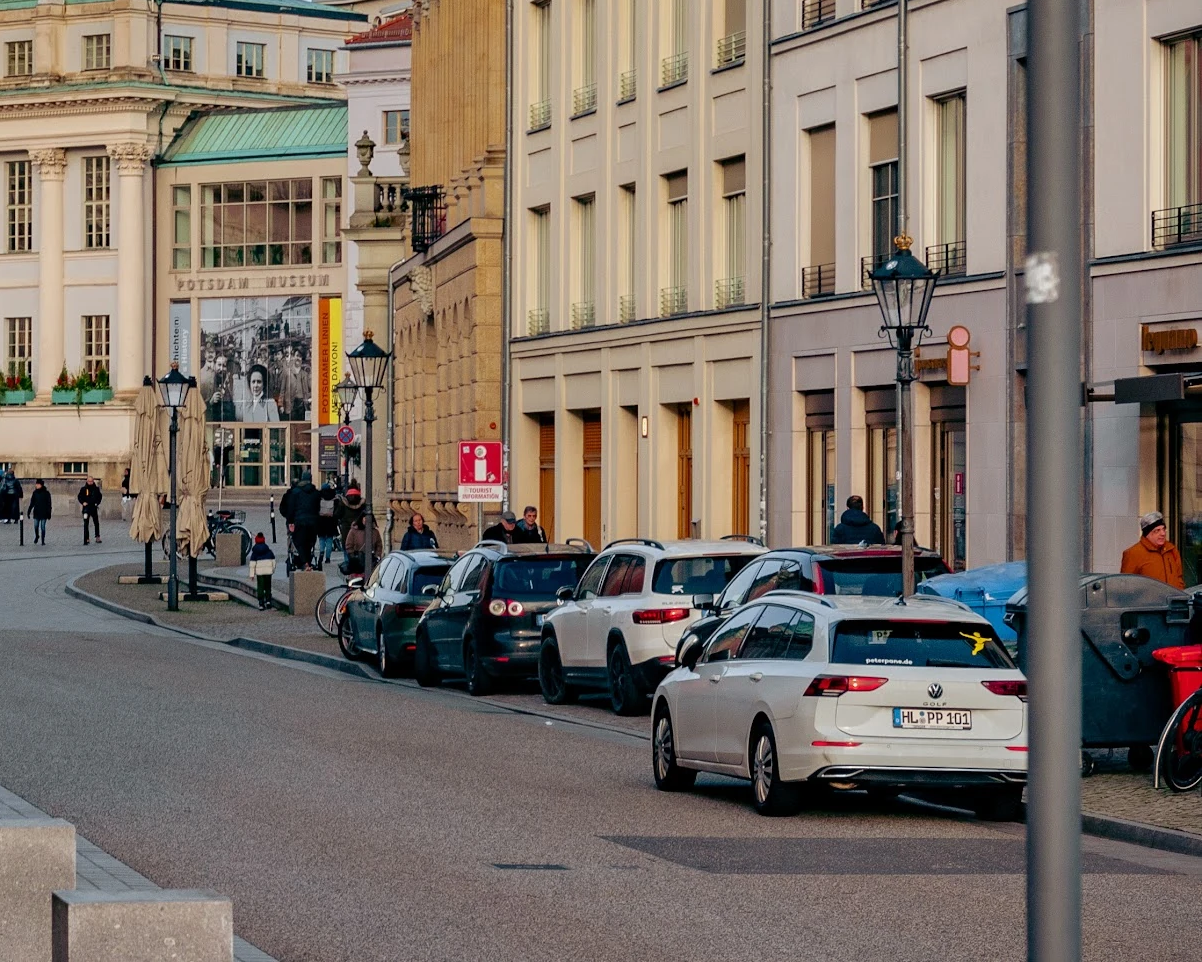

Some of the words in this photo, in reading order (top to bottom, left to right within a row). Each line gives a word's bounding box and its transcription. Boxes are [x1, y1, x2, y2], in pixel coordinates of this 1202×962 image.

[177, 277, 249, 291] POTSDAM
[266, 274, 330, 288] MUSEUM
[331, 341, 339, 381] DAVON!
[902, 710, 919, 724] HL
[927, 711, 943, 725] PP
[946, 712, 970, 725] 101
